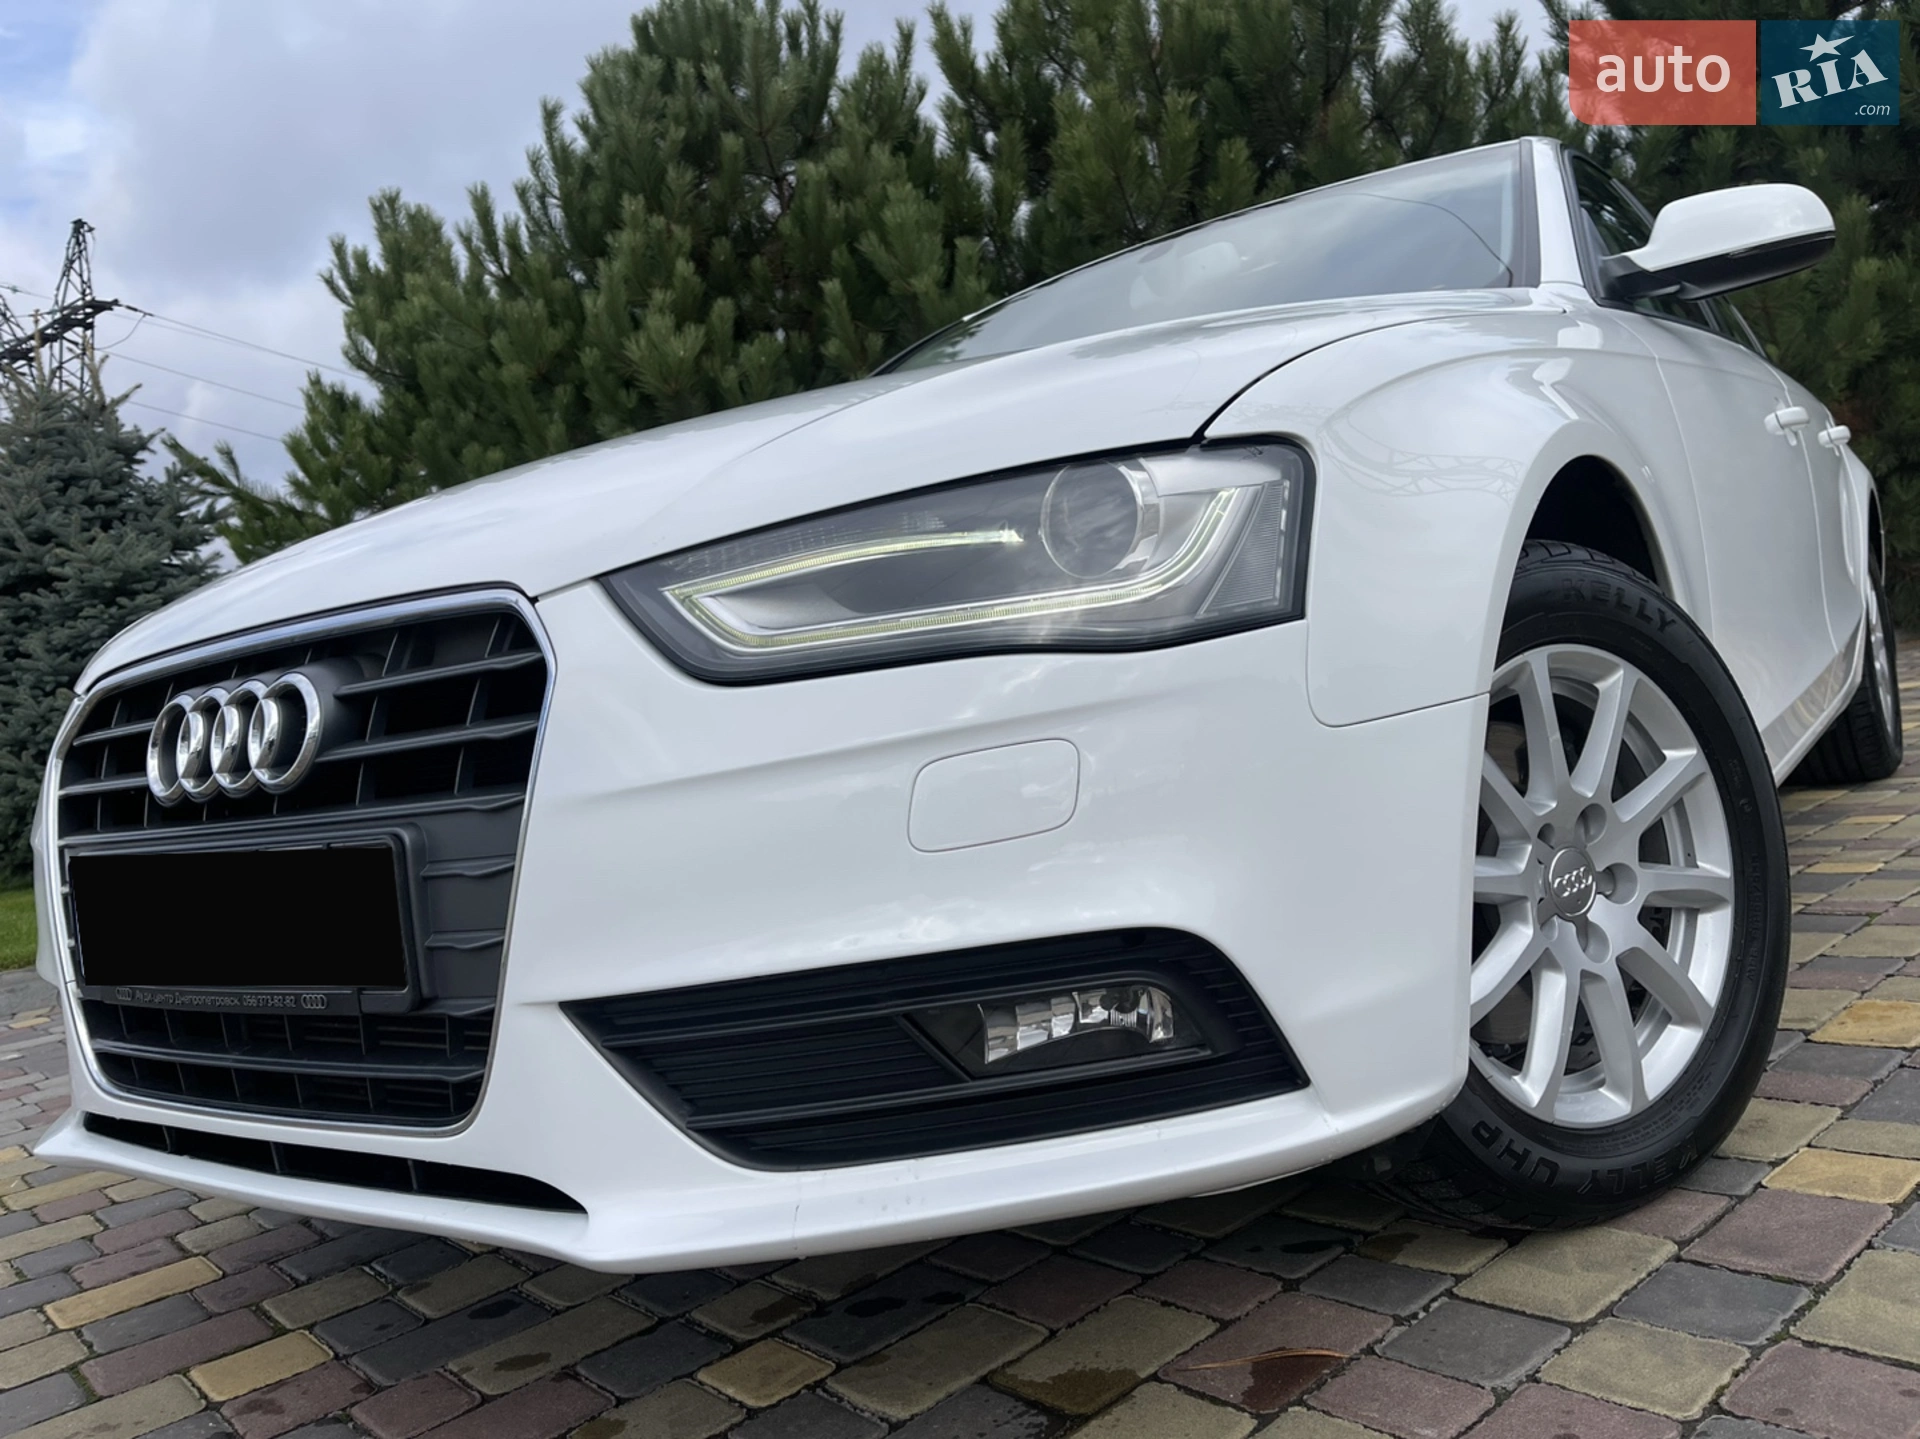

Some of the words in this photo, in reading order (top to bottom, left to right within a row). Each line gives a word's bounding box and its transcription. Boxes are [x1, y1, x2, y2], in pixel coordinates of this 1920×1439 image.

[1561, 577, 1677, 634] KELLY
[1471, 1119, 1561, 1189] UHP
[1576, 1131, 1701, 1196] KELLY
